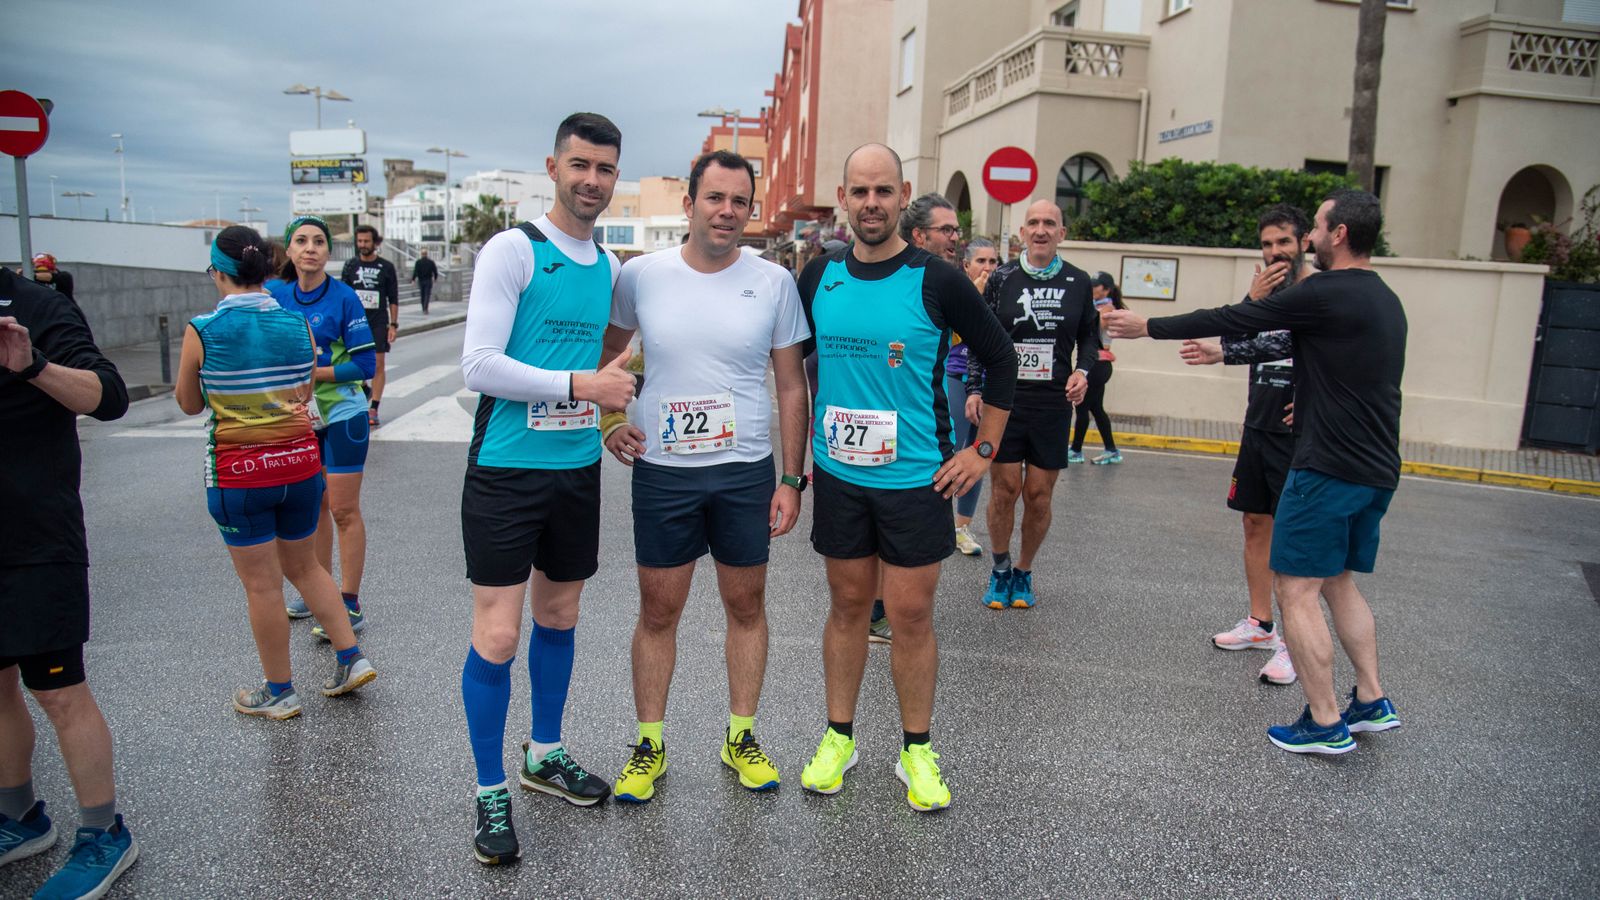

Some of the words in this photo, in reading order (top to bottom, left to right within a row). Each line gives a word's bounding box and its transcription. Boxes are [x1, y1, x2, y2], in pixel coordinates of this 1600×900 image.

[1033, 288, 1065, 299] XIV
[544, 319, 600, 330] AYUNTAMIENTO
[835, 344, 868, 352] FACINAS
[669, 401, 692, 413] XIV
[704, 403, 731, 411] ESTRECHO
[682, 411, 710, 435] 22
[833, 411, 855, 424] XIV
[843, 424, 868, 446] 27
[231, 460, 258, 474] C.D.
